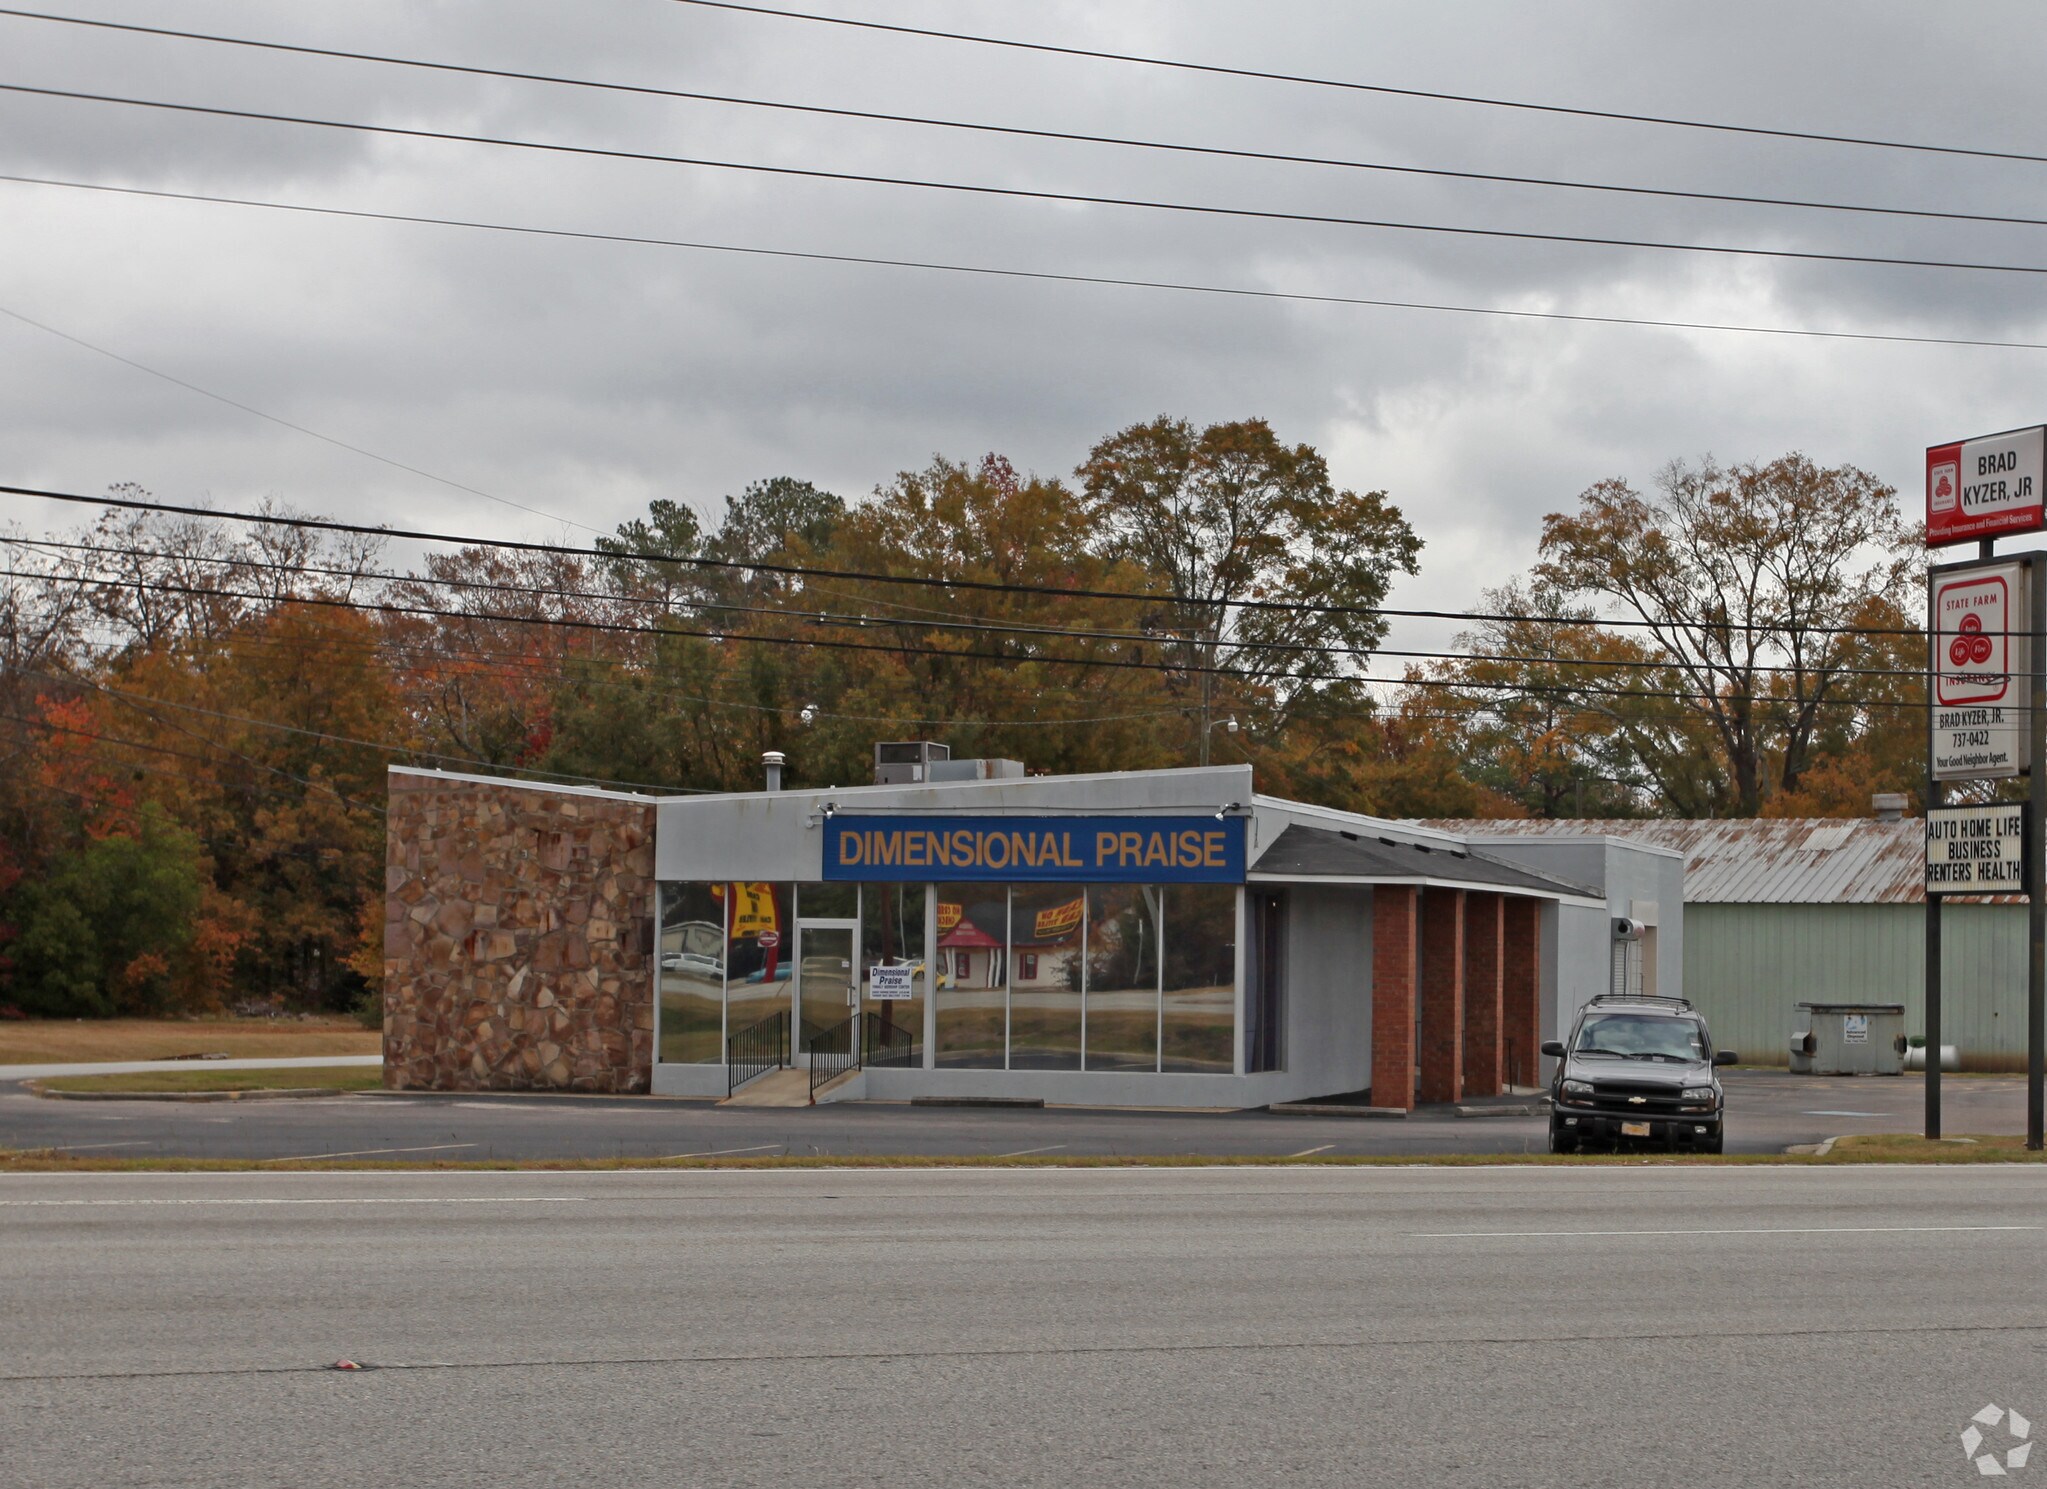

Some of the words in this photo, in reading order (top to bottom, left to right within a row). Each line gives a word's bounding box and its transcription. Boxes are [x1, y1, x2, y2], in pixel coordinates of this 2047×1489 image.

[1978, 451, 2016, 476] BRAD
[1963, 481, 2010, 506] KYZER,
[2014, 476, 2032, 498] JR
[1952, 522, 1976, 533] Insurance
[1976, 519, 1986, 529] and
[1986, 515, 2009, 528] Financial
[2009, 513, 2032, 524] Services
[1946, 597, 1969, 611] STATE
[1973, 593, 1998, 607] FARM
[1954, 647, 1966, 658] Life
[1974, 644, 1987, 654] Fire
[1940, 712, 1961, 728] BRAD
[1962, 709, 1990, 727] KYZER,
[1991, 707, 2004, 724] JR.
[1952, 730, 1989, 748] 737-0422
[1936, 755, 1948, 768] Your
[1948, 754, 1963, 767] Good
[1963, 753, 1988, 768] Neighbor
[1988, 751, 2008, 766] Agent.
[1928, 820, 1957, 840] AUTO
[1961, 818, 1991, 838] HOME
[1996, 816, 2020, 837] LIFE
[839, 829, 1083, 869] DIMENSIONAL
[1095, 830, 1227, 869] PRAISE
[1948, 840, 2001, 859] BUSINESS
[1928, 862, 1972, 882] RENTERS
[1978, 861, 2020, 880] HEALTH
[872, 967, 911, 976] Dimensional
[879, 976, 903, 985] Praise
